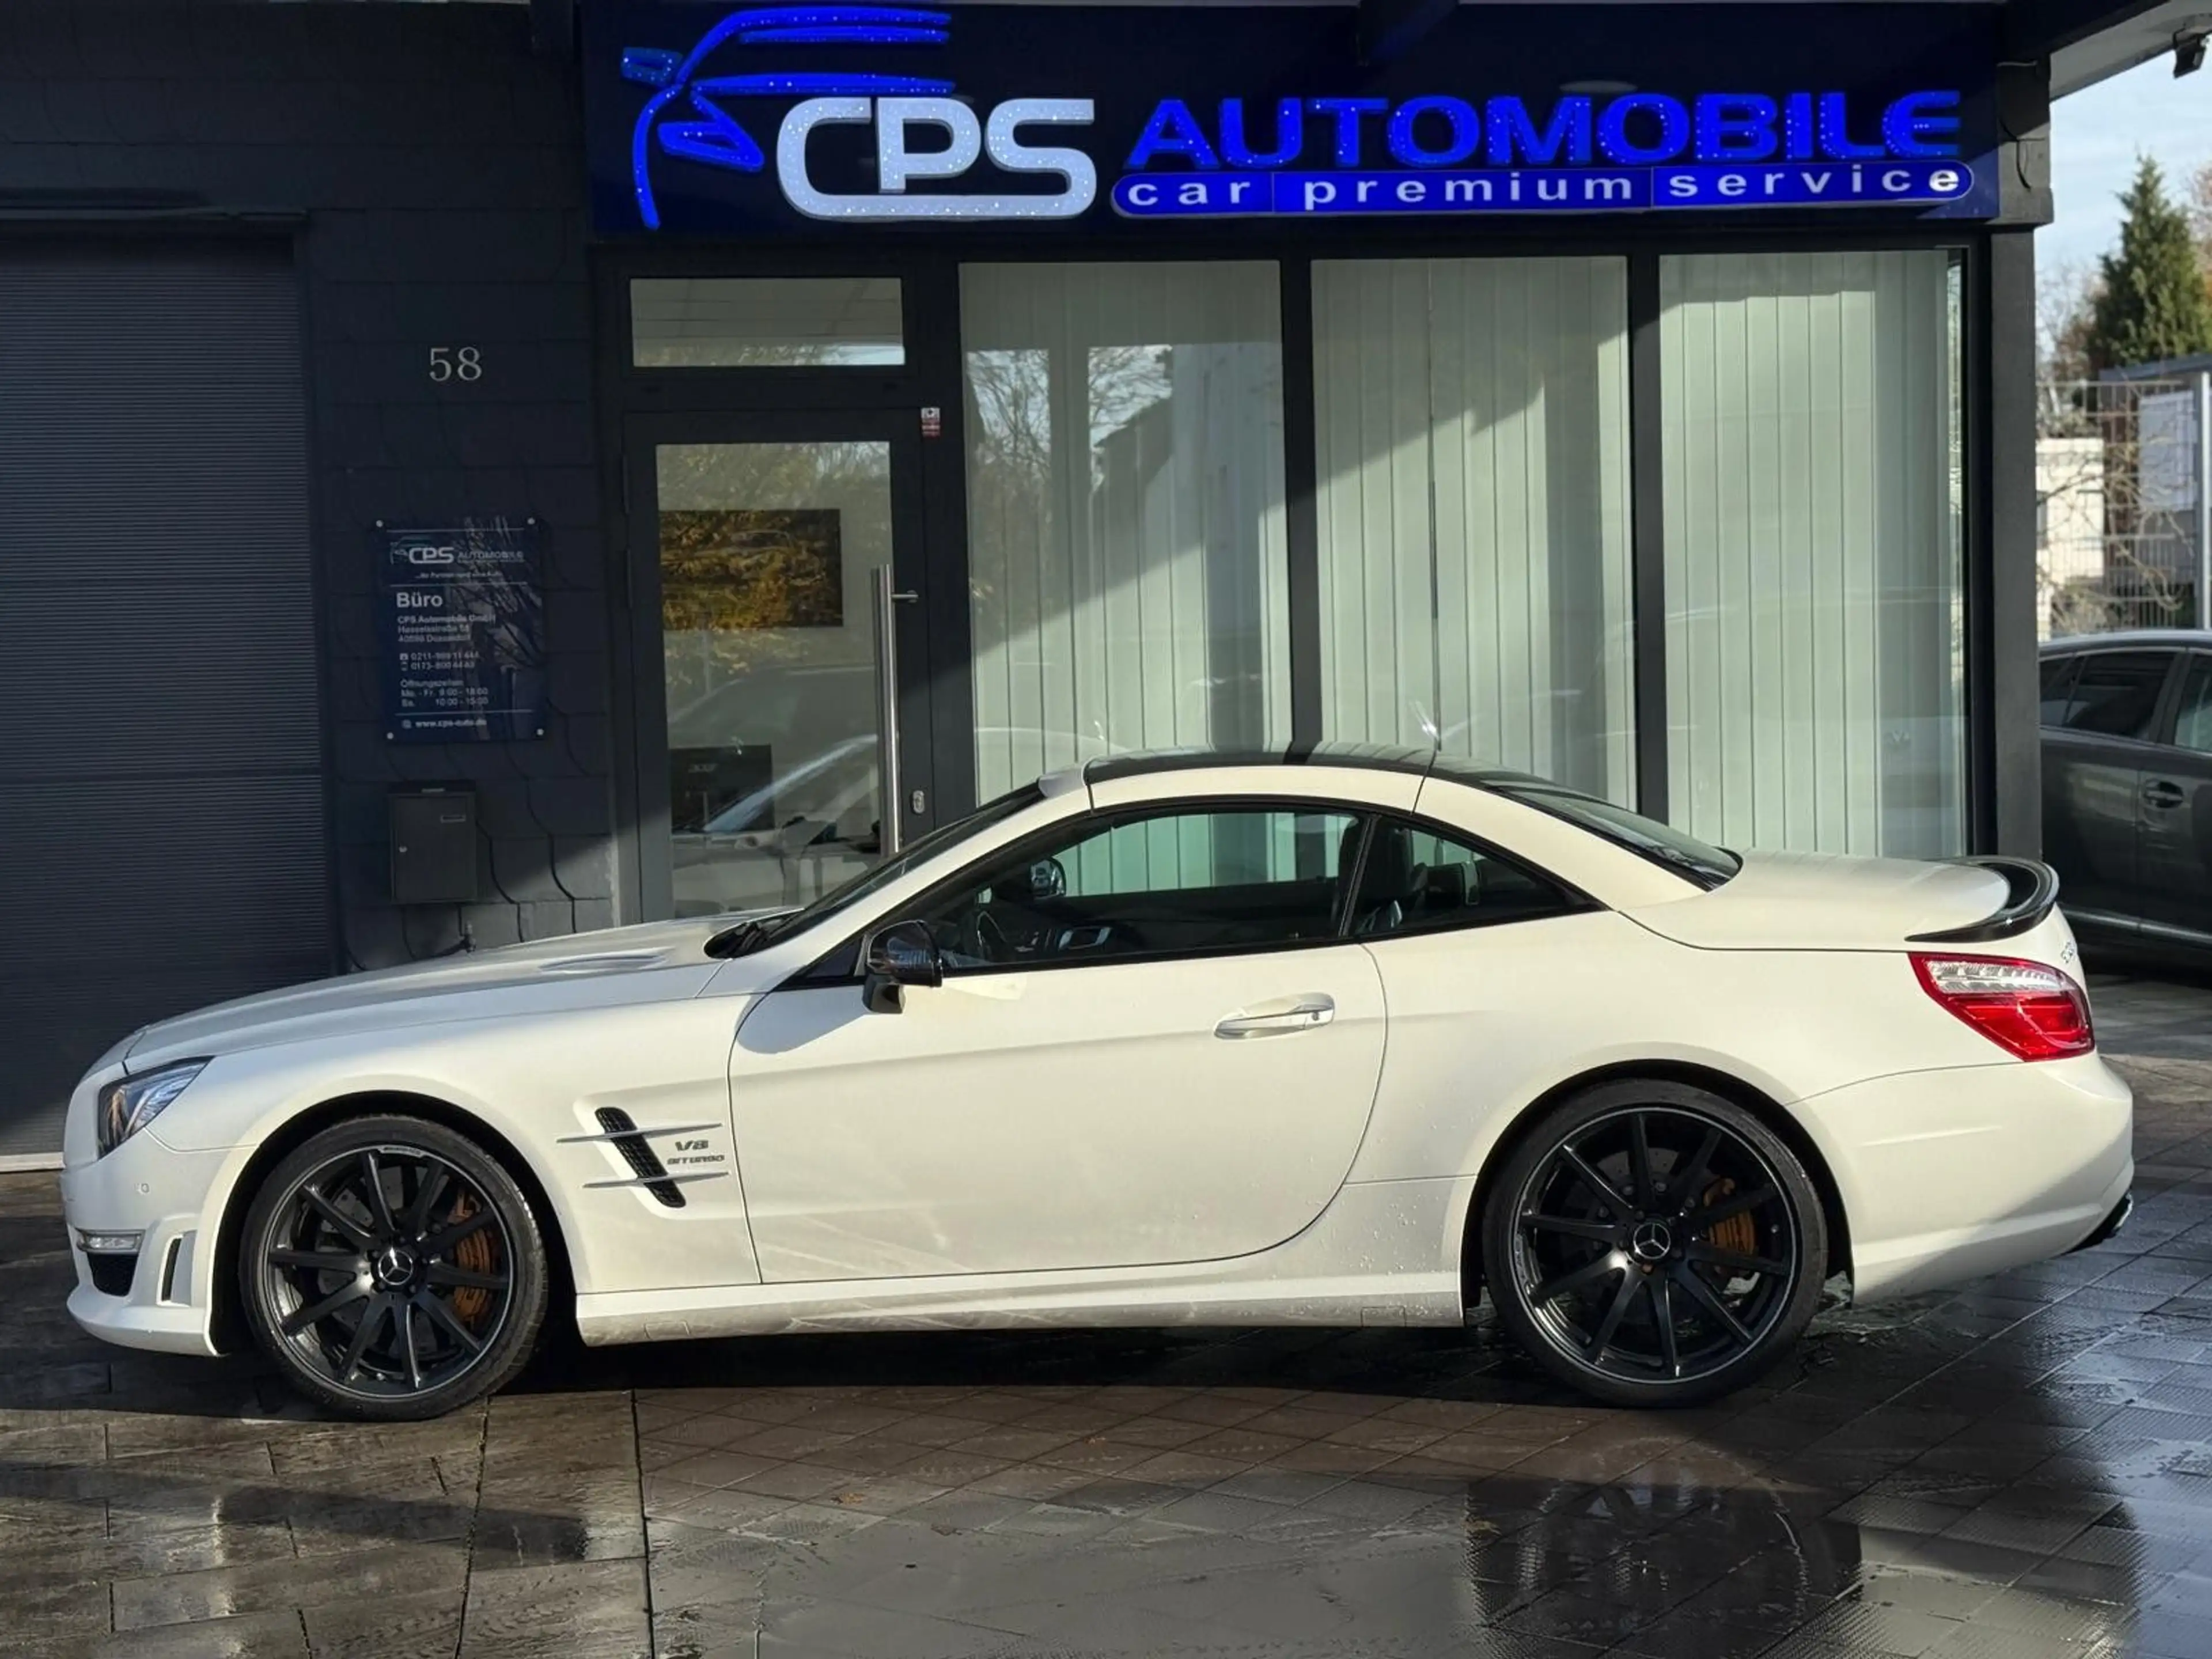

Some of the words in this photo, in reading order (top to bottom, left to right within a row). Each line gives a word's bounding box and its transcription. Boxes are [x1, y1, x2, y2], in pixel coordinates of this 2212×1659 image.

[777, 97, 1097, 221] CPS
[1124, 90, 1961, 169] AUTOMOBILE
[1127, 180, 1251, 206] car
[1304, 172, 1632, 211] premium
[1669, 164, 1959, 197] service
[429, 347, 482, 382] 58
[409, 547, 454, 564] CPS
[396, 592, 443, 608] Büro
[675, 1139, 709, 1151] V8
